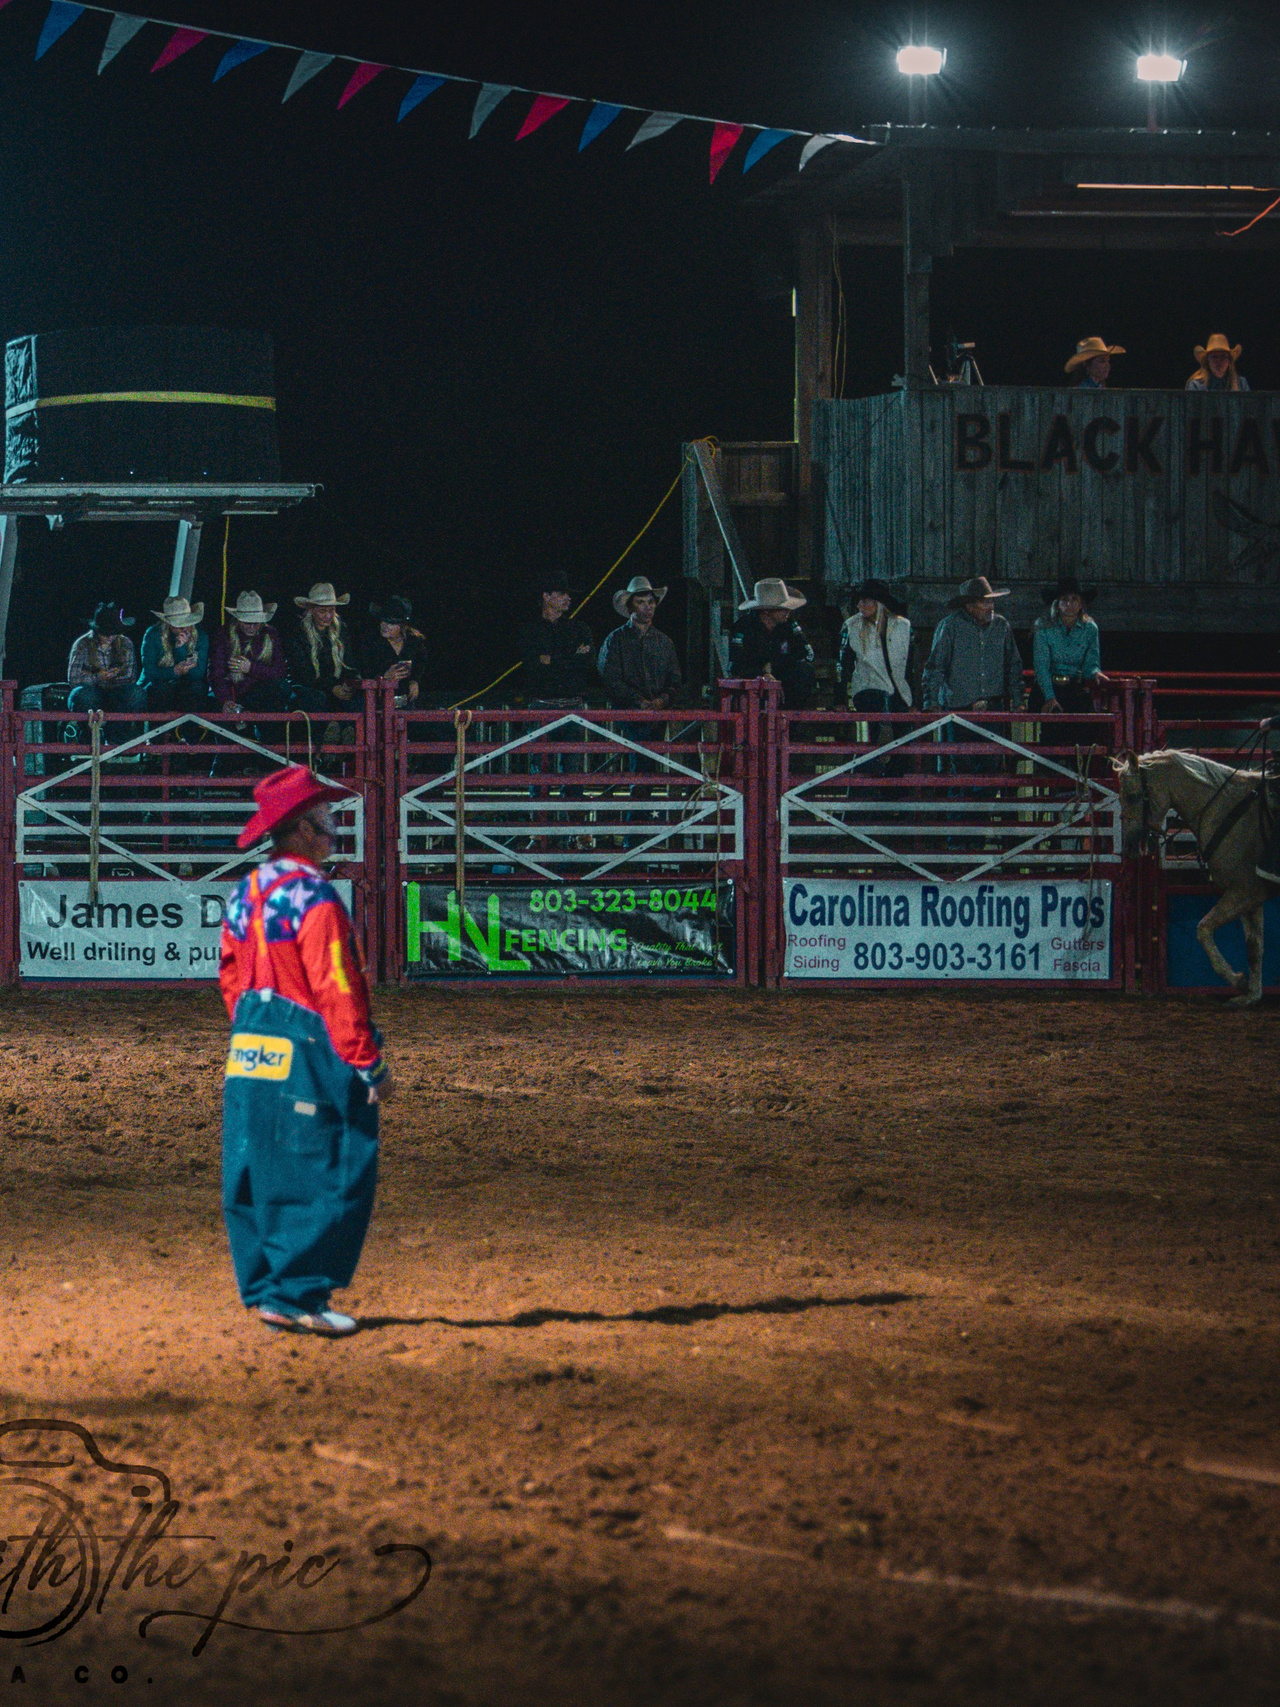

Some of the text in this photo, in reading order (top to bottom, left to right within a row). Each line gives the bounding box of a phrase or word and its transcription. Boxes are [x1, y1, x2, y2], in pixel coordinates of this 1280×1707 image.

[954, 412, 1165, 477] BLACK
[47, 893, 227, 929] James D
[529, 888, 717, 913] 803-323-8044
[788, 883, 1106, 939] Carolina Roofing Pros
[505, 929, 628, 952] FENCING
[787, 933, 847, 951] Roofing
[1050, 936, 1106, 951] Gutters
[26, 941, 222, 967] Well driling & pu
[793, 955, 841, 972] Siding
[853, 942, 1041, 971] 803-903-3161
[1053, 958, 1101, 972] Fascia
